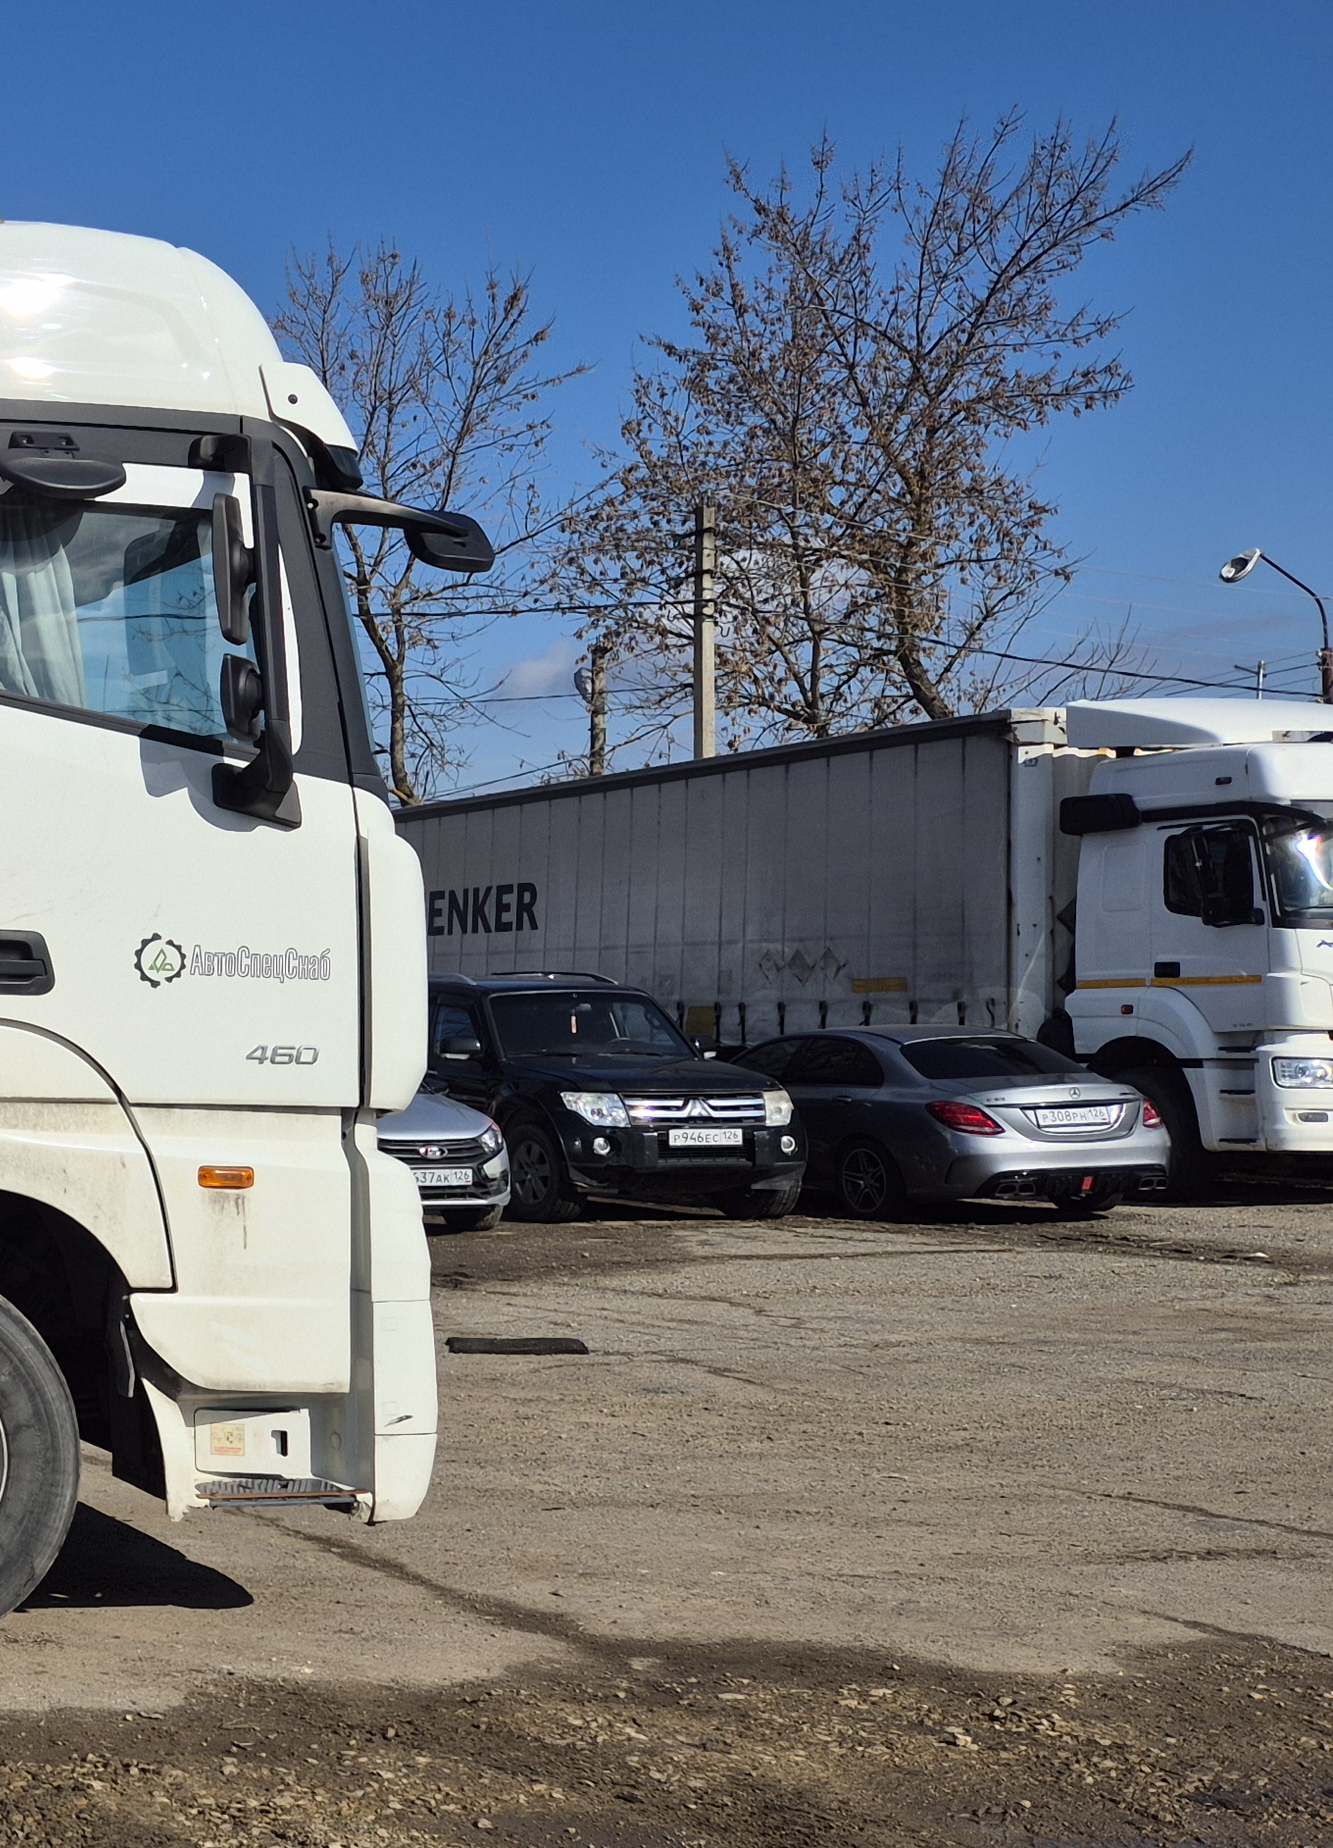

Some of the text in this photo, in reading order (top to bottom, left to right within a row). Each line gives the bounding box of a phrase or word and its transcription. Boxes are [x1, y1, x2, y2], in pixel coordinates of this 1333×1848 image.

[427, 882, 539, 936] ENKER
[189, 944, 331, 984] АвтоСпецСнаб
[245, 1044, 320, 1065] 460
